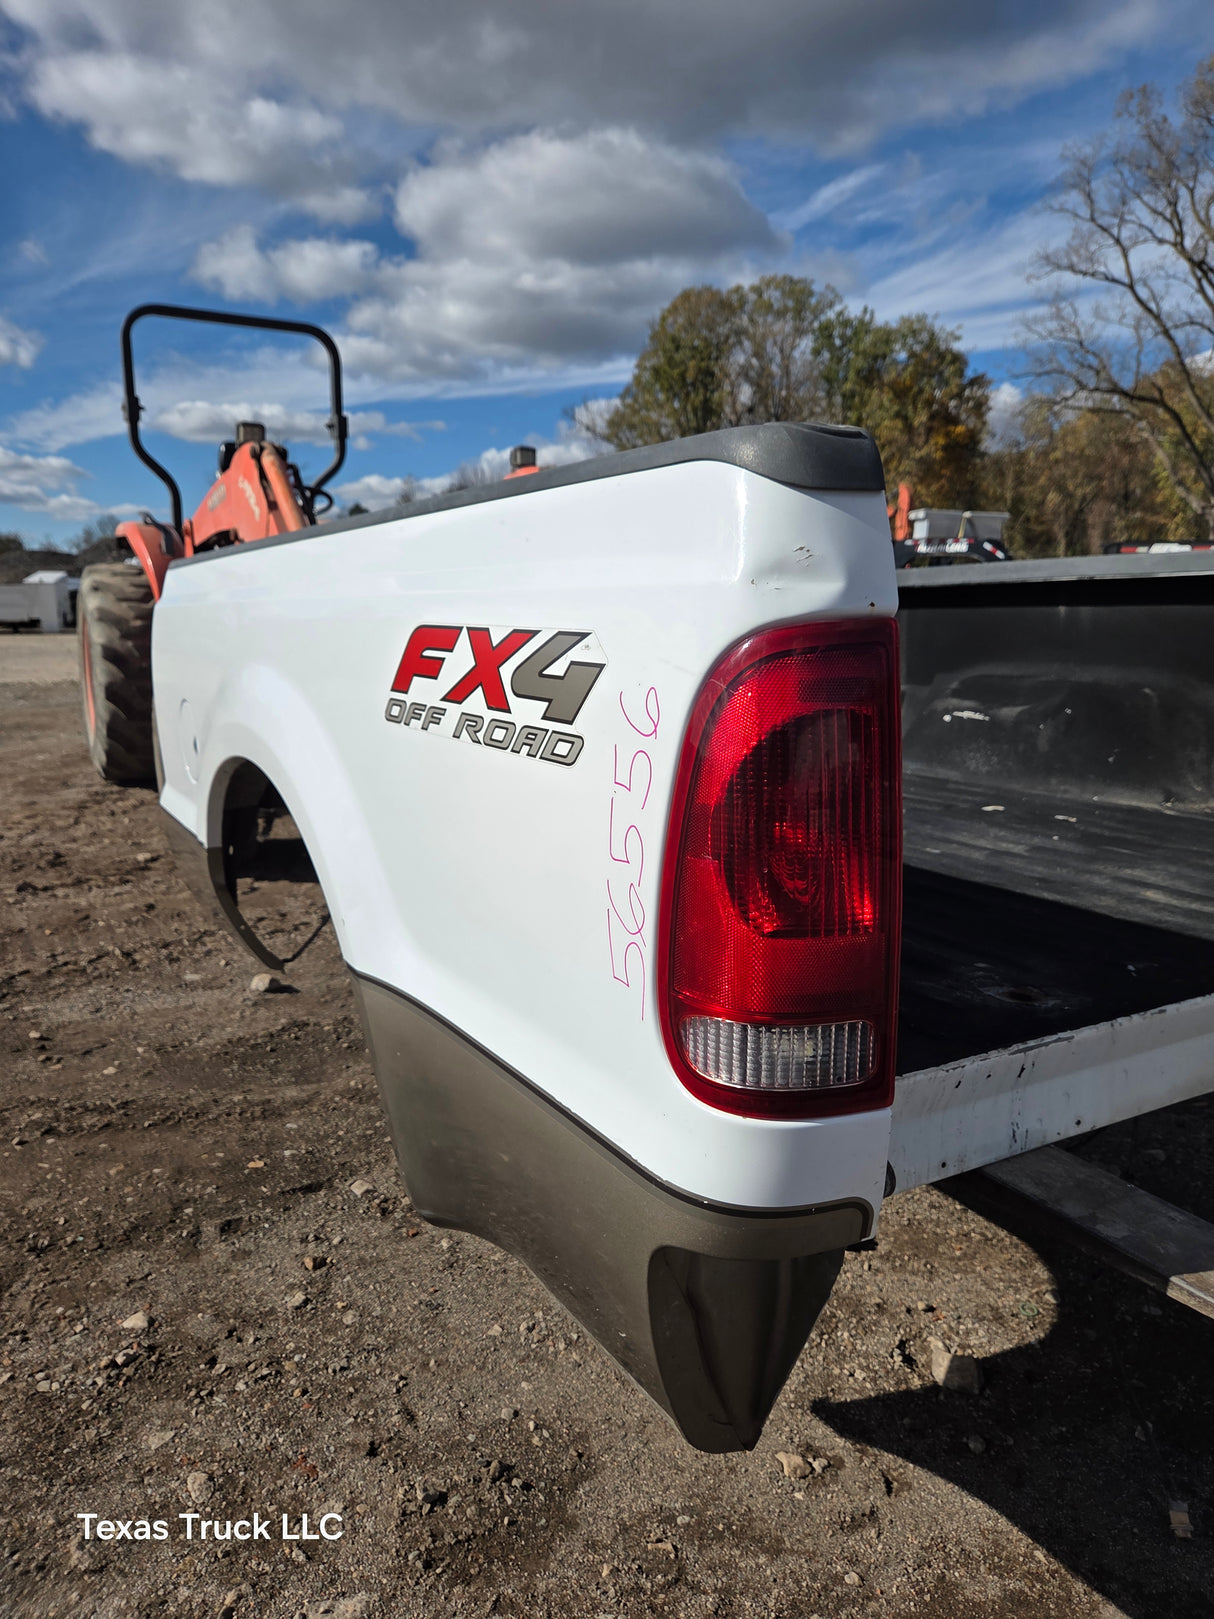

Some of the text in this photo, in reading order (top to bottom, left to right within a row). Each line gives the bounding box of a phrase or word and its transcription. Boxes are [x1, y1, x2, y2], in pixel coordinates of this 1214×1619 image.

[390, 624, 606, 725] FX4
[384, 697, 584, 767] OFF ROAD
[607, 687, 660, 1021] 56556
